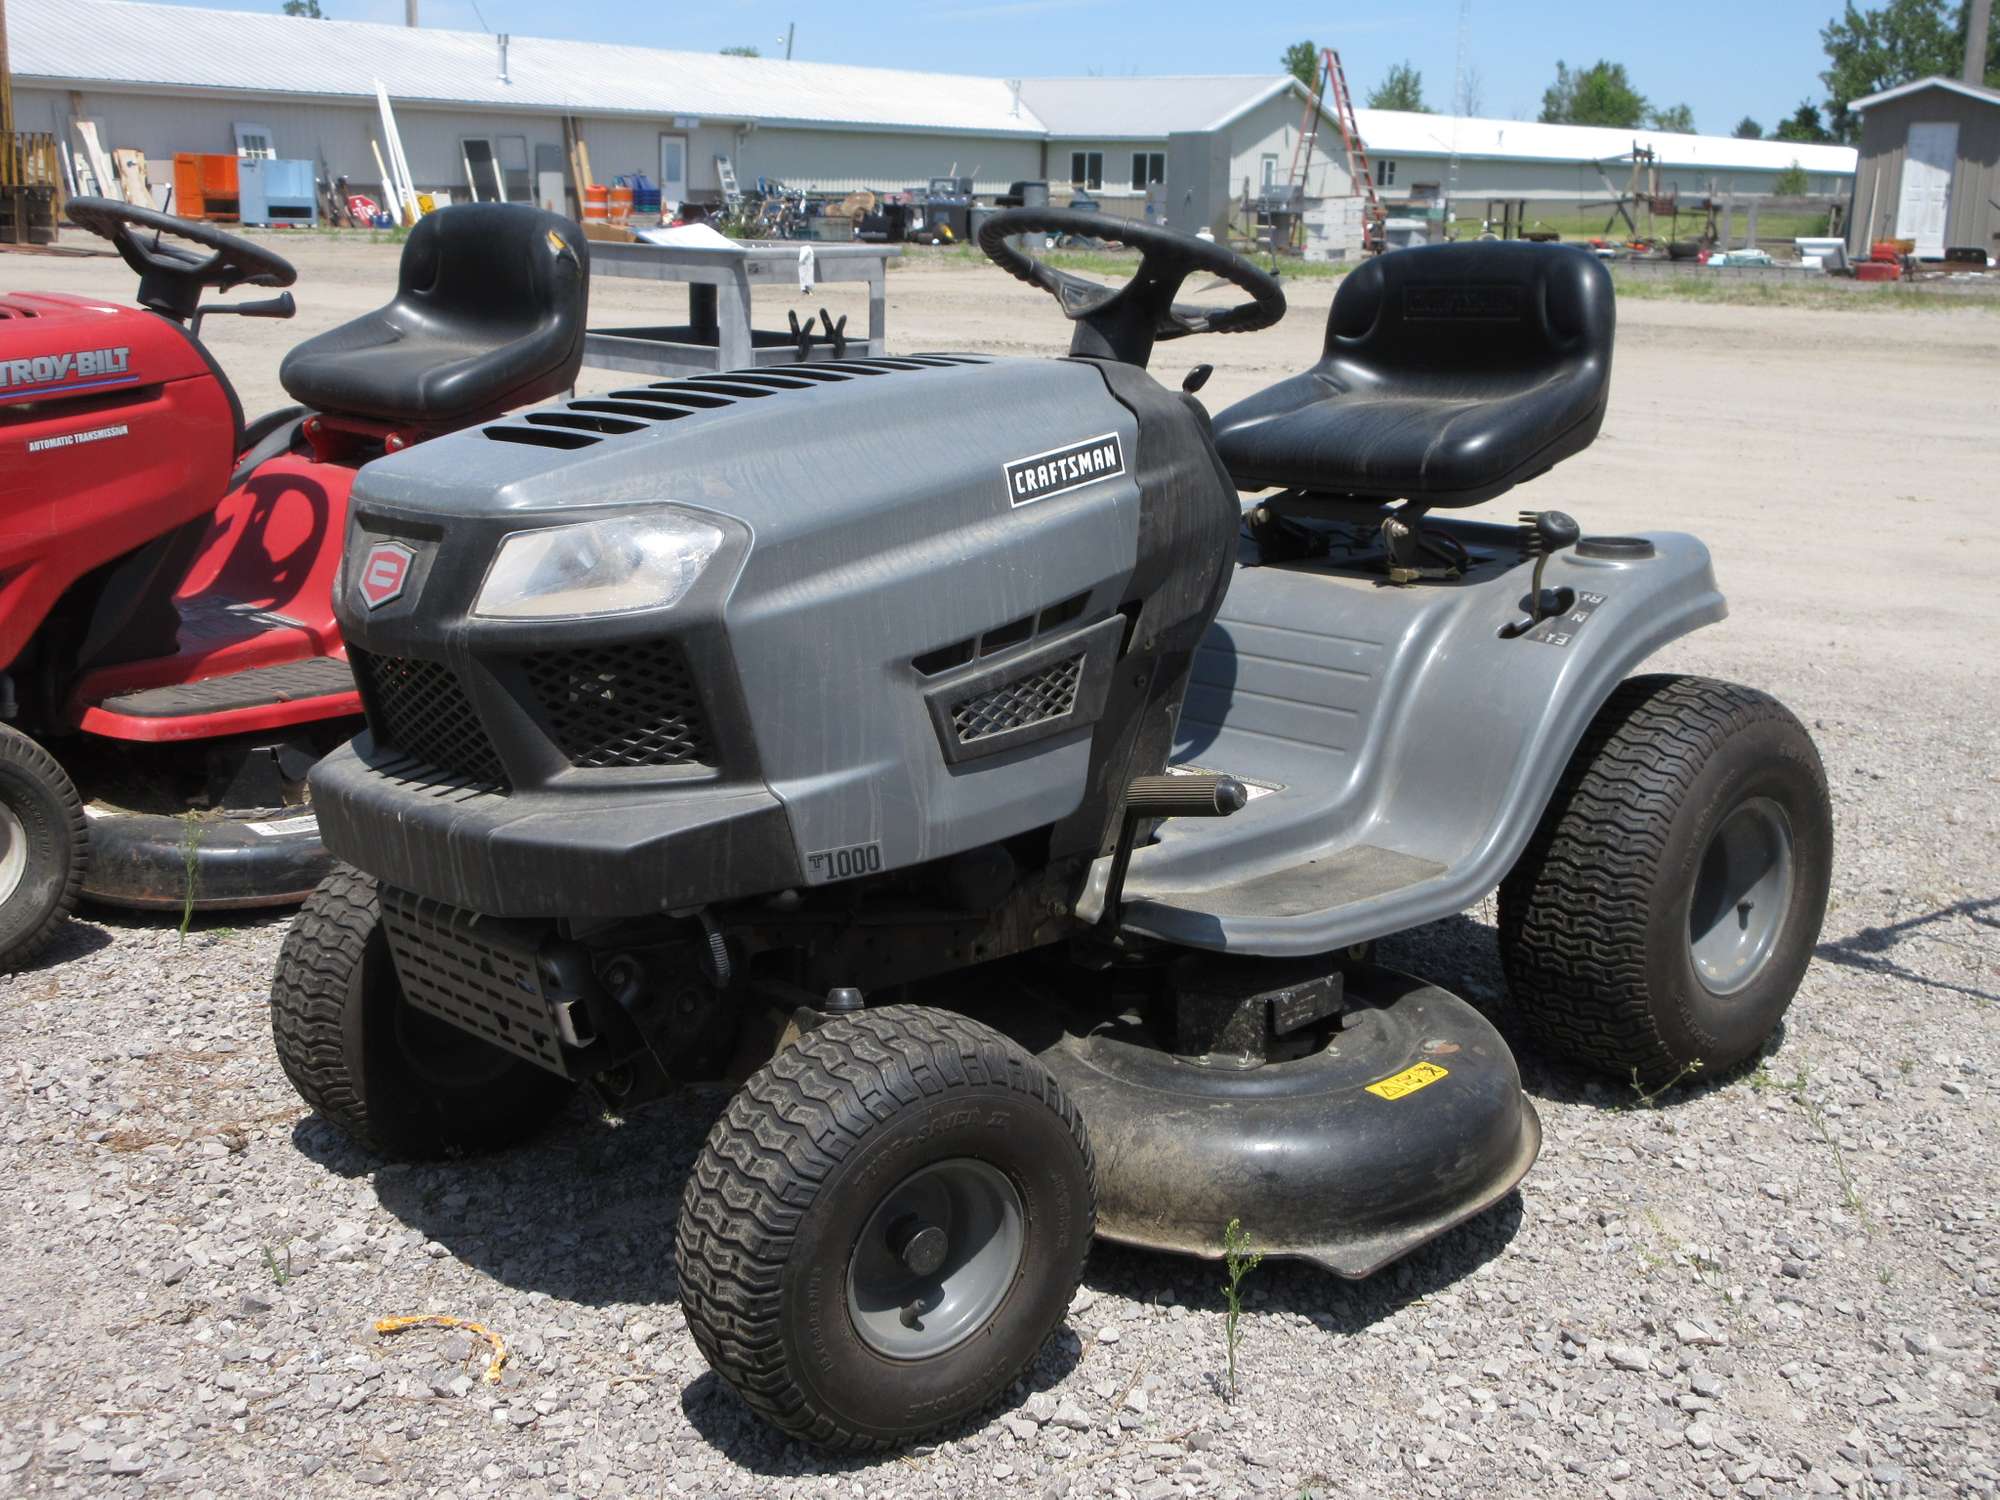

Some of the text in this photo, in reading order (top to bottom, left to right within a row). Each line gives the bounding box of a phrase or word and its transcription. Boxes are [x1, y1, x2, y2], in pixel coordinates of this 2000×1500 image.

[0, 348, 129, 386] TROY-BILT
[29, 424, 128, 452] AUTOMATIC TRANSMISSION
[1015, 445, 1116, 494] CRAFTSMAN
